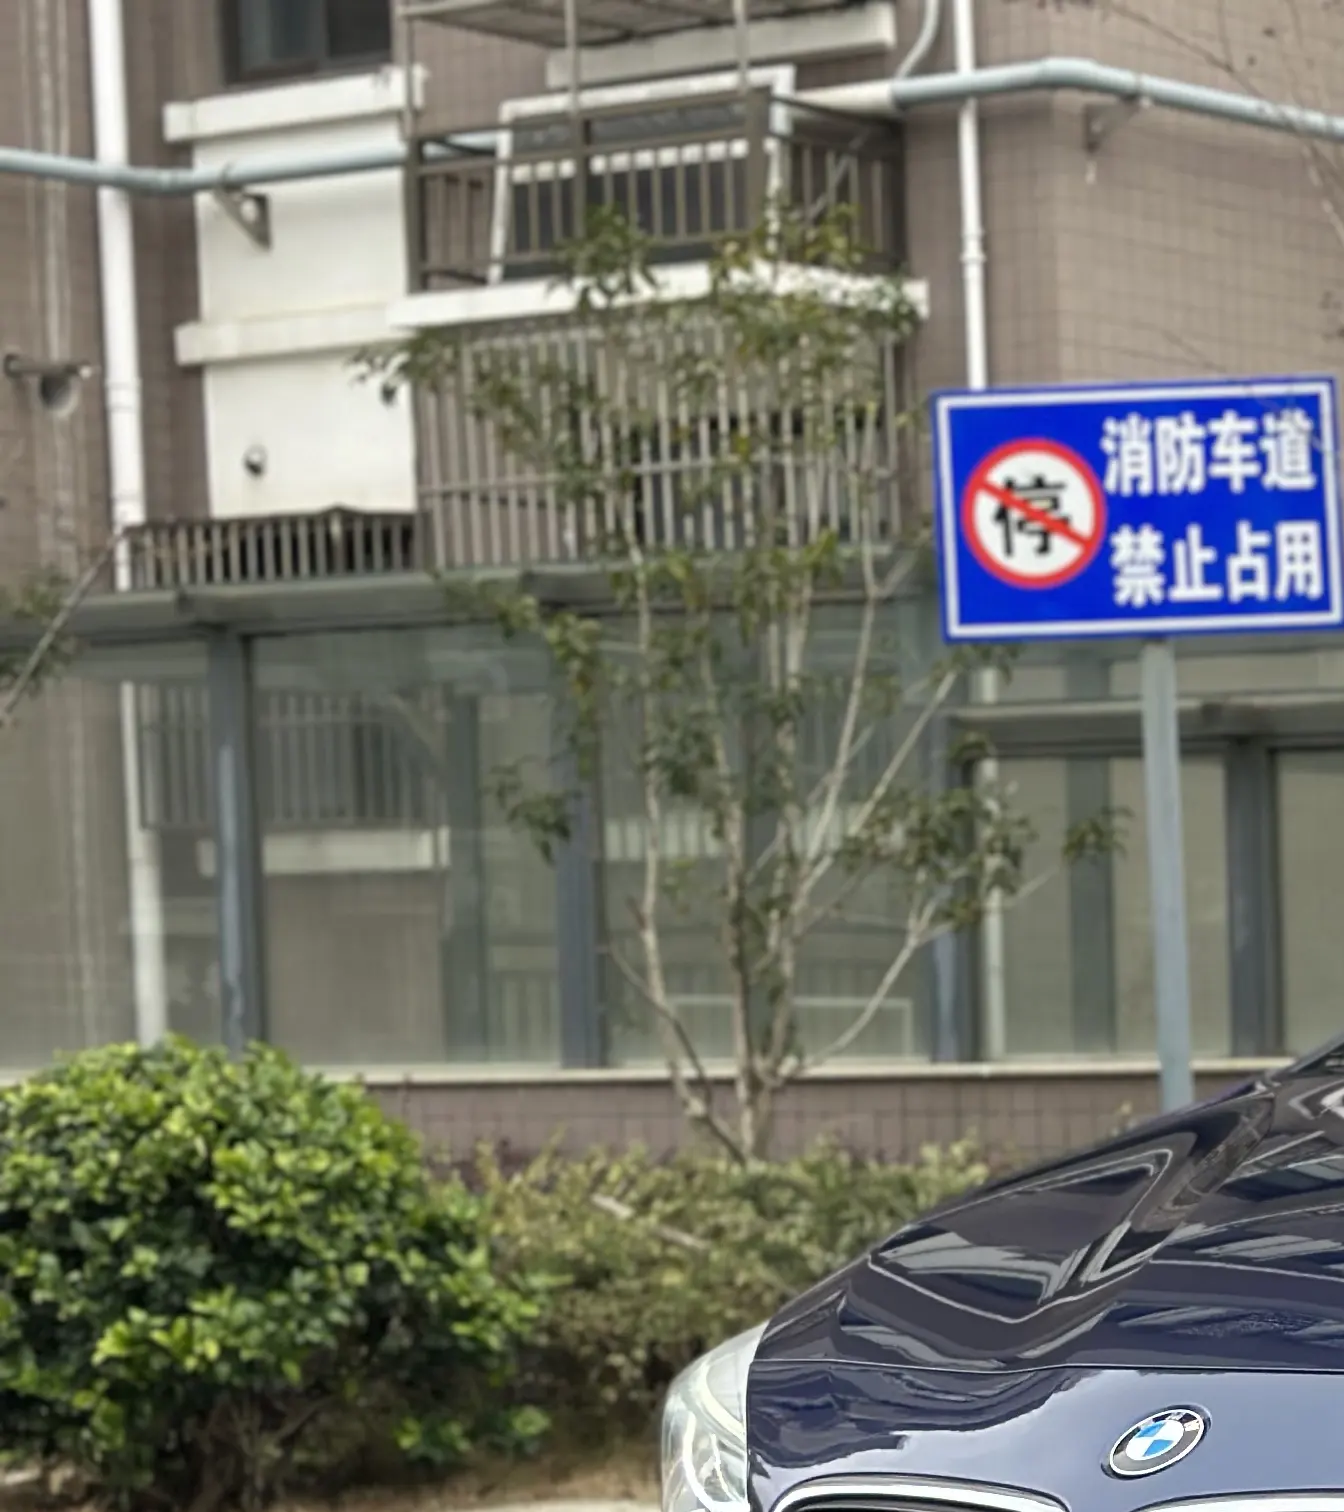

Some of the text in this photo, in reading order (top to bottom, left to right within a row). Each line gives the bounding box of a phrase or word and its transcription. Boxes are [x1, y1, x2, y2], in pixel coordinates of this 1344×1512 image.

[1100, 408, 1317, 496] 消防车道
[992, 475, 1071, 557] 停
[1110, 519, 1324, 607] 禁止占用
